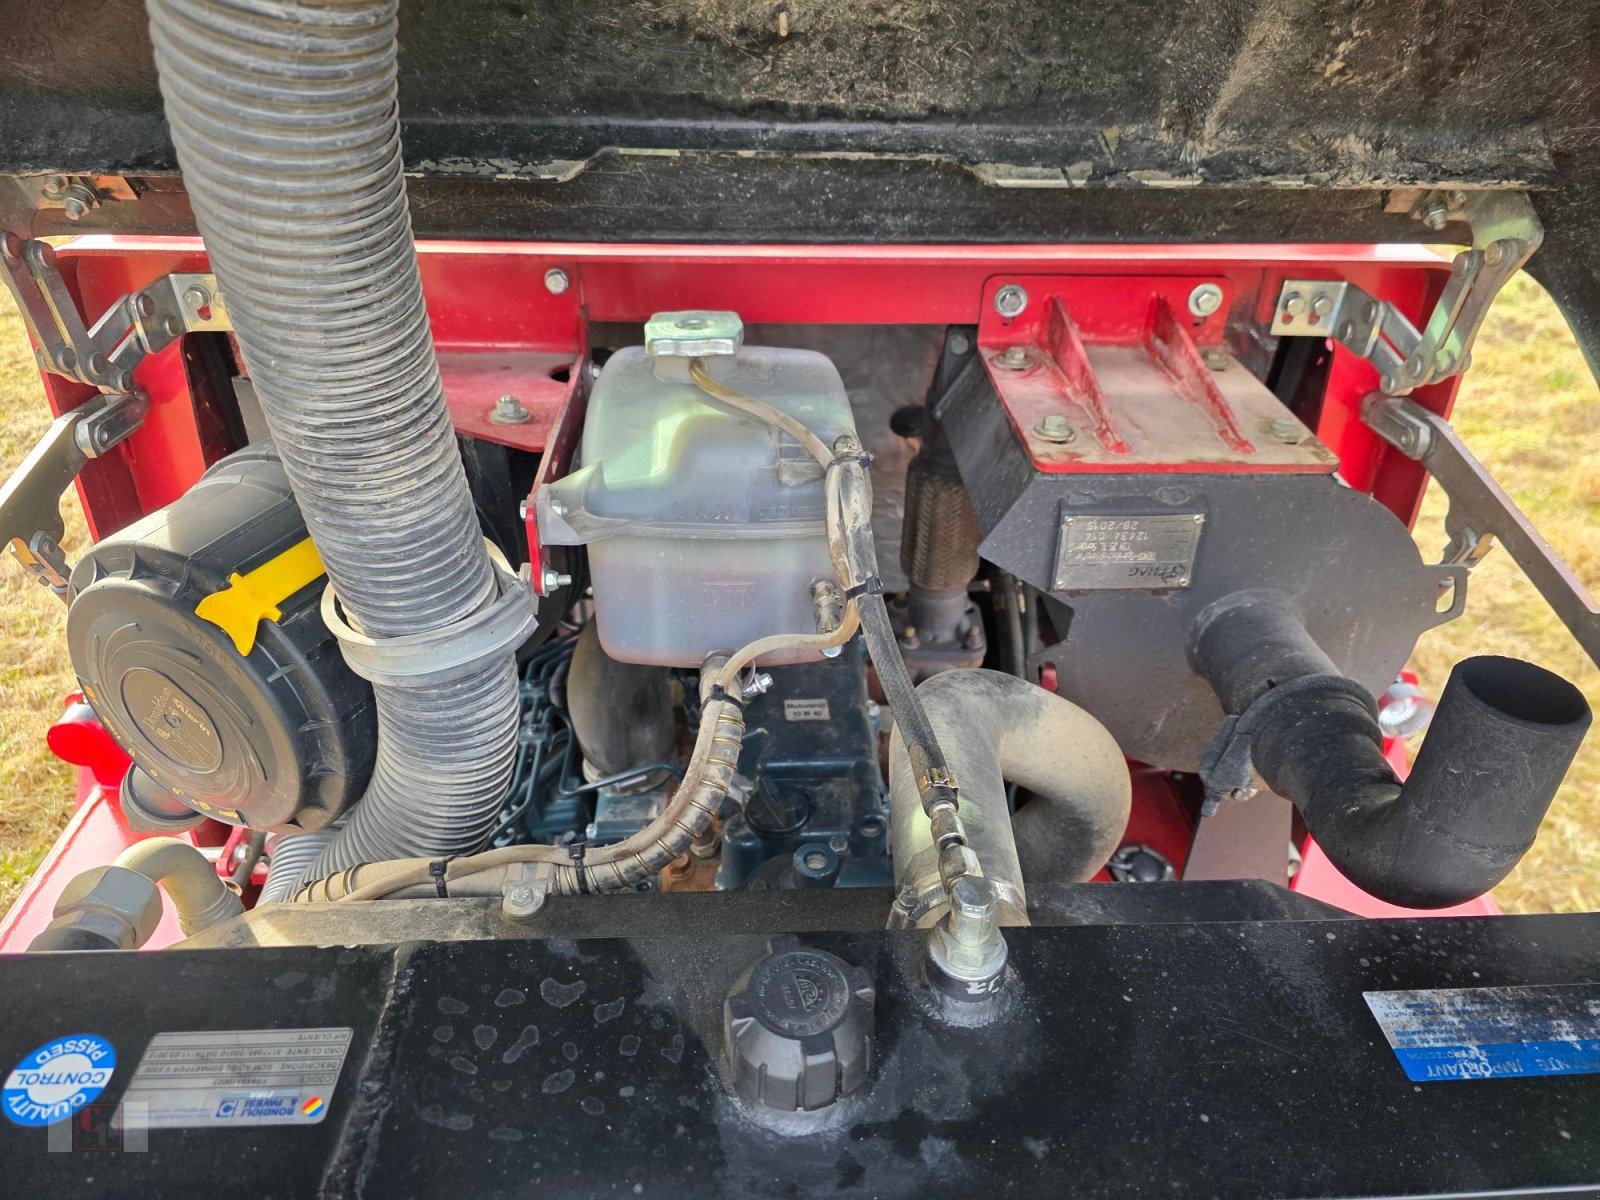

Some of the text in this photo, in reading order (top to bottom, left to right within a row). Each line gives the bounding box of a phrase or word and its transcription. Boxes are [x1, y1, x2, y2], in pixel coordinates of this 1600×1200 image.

[35, 1039, 109, 1066] PASSED
[1426, 1058, 1524, 1078] IMPORTANT
[17, 1072, 106, 1086] CONTROL
[8, 1092, 87, 1121] QUALITY
[244, 1098, 284, 1108] PAVESI
[240, 1106, 296, 1118] BONDIOLI
